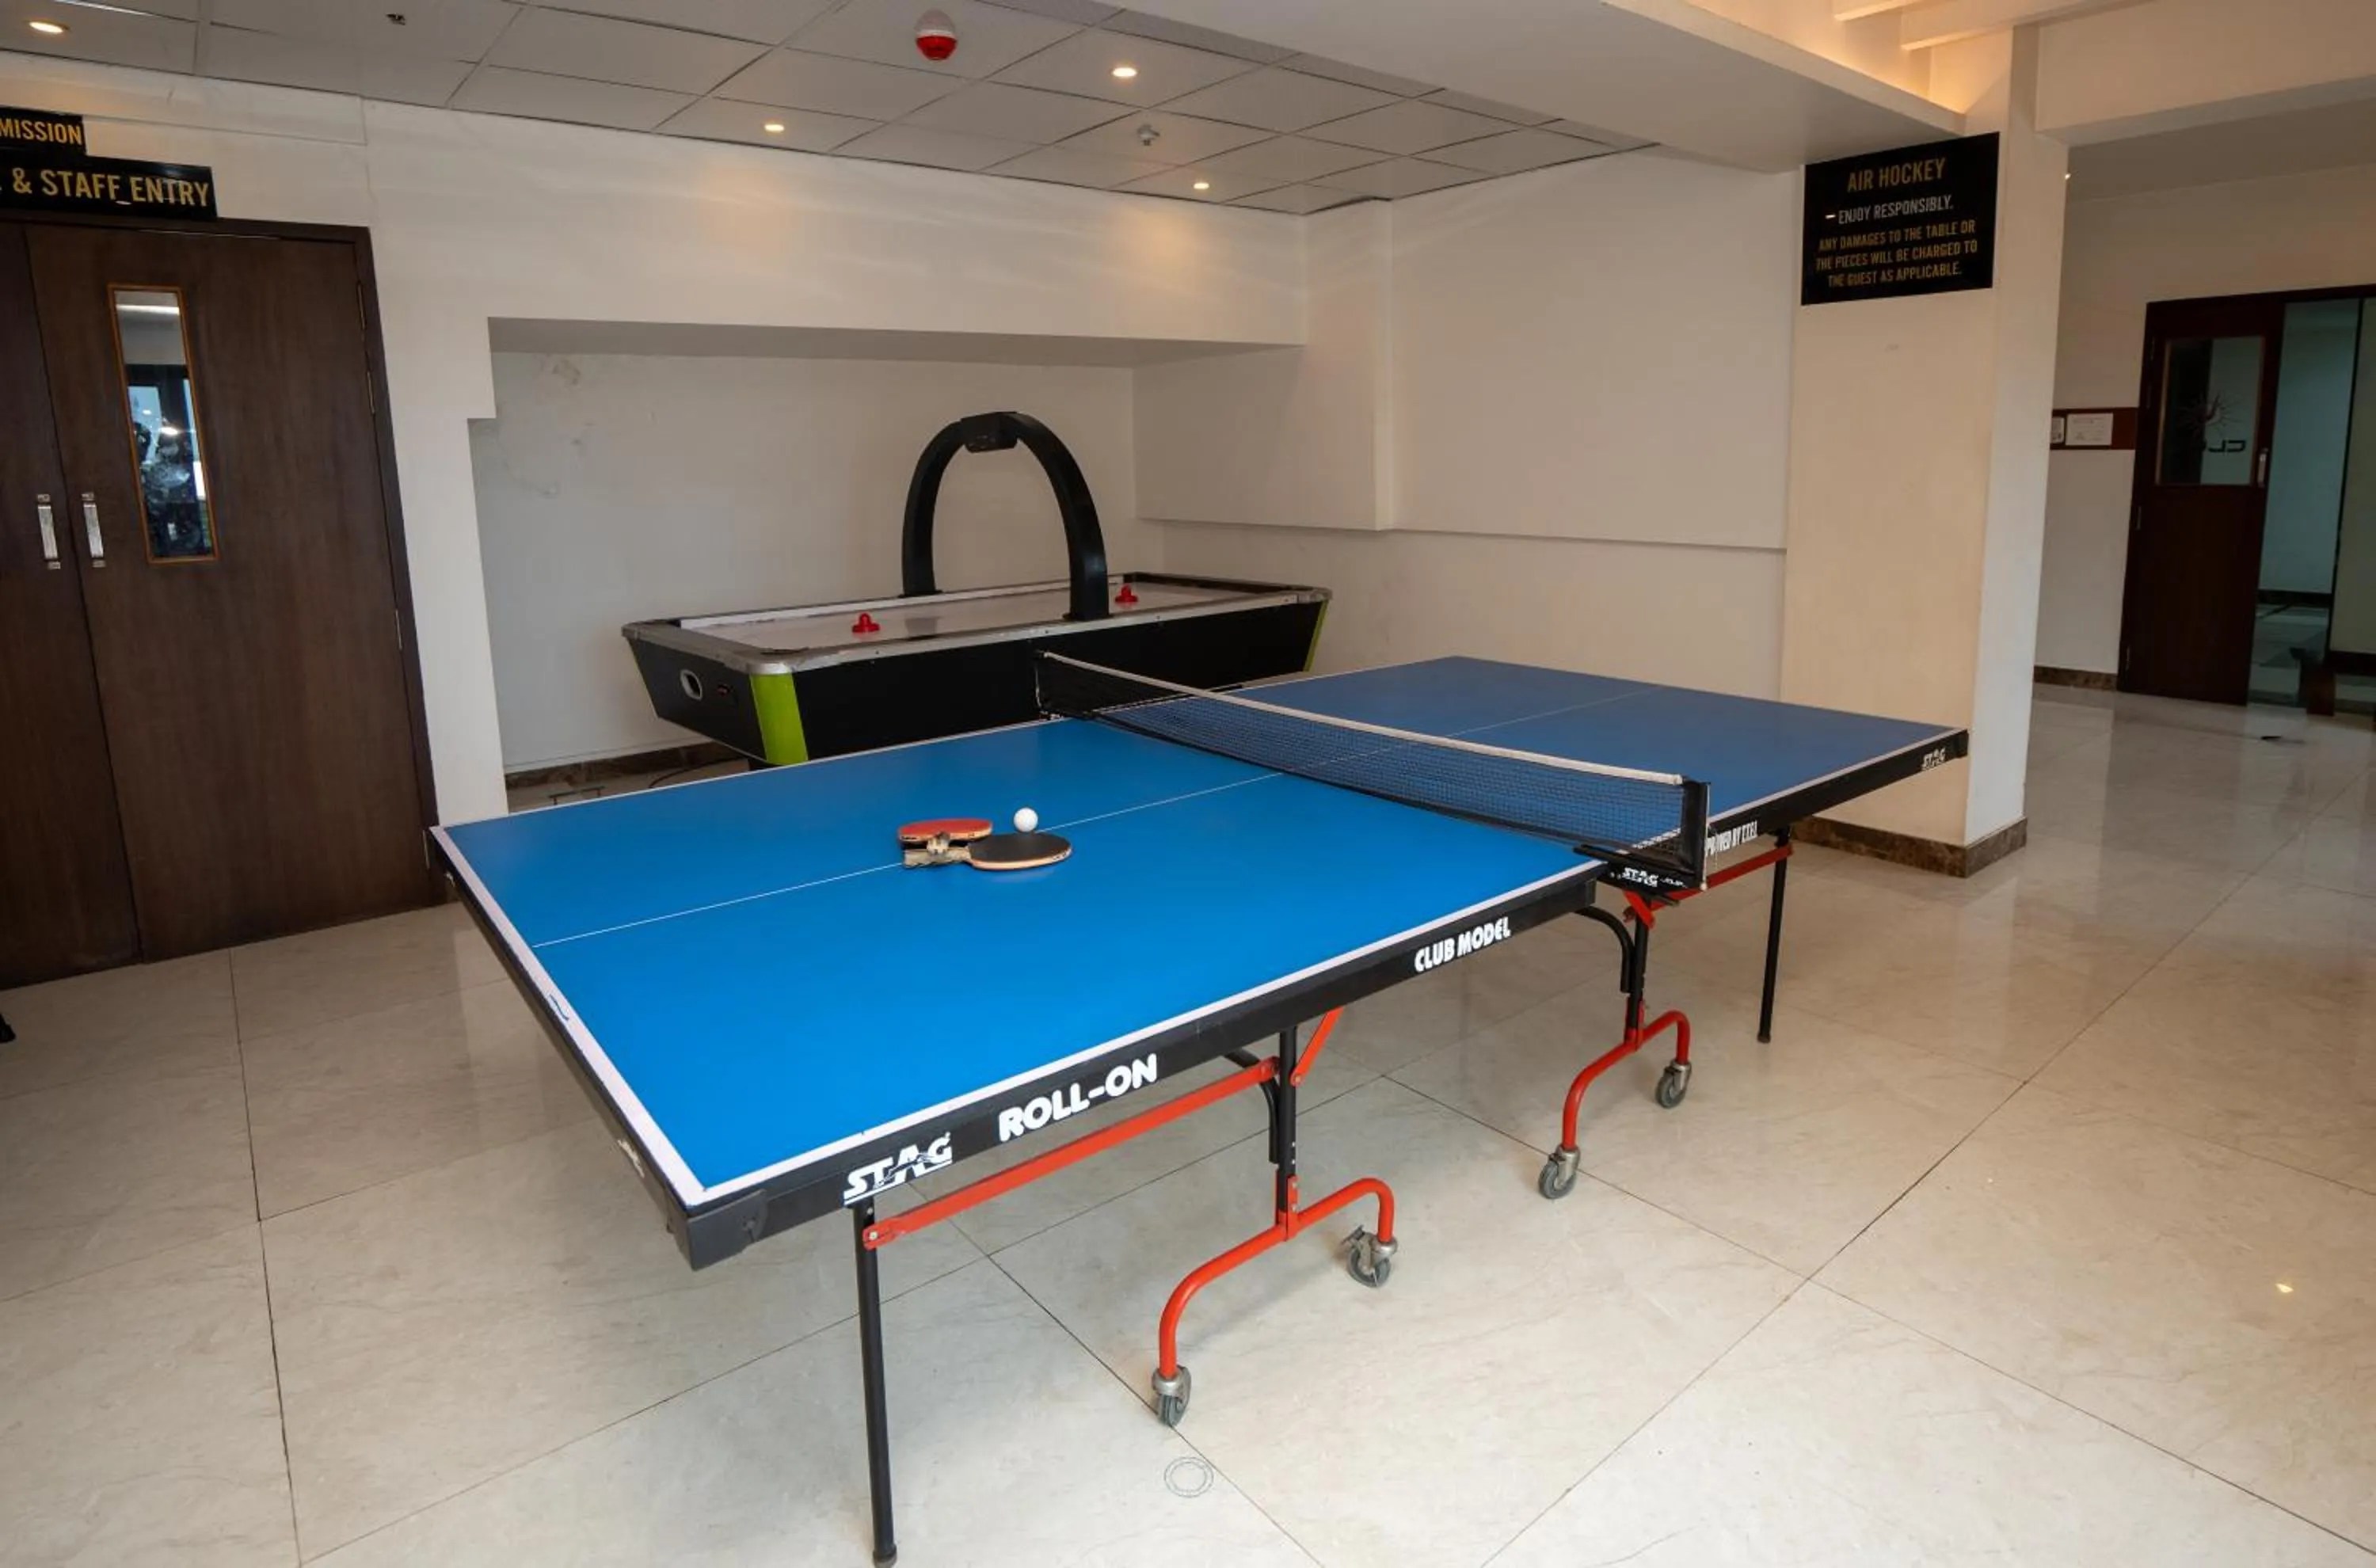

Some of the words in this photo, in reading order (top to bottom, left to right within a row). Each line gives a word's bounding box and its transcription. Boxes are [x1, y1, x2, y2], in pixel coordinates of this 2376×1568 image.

[12, 167, 32, 194] &
[40, 169, 120, 200] STAFF
[129, 176, 209, 207] ENTRY
[1847, 169, 1874, 193] AIR
[1879, 158, 1946, 188] HOCKEY
[1838, 205, 1871, 224] ENJOY
[1873, 195, 1954, 220] RESPONSIBLY.
[1818, 237, 1837, 252] ANY
[1840, 231, 1887, 249] DAMAGES
[1888, 230, 1901, 244] TO
[1904, 226, 1923, 242] THE
[1925, 221, 1959, 238] TABLE
[1960, 219, 1976, 234] OR
[1816, 257, 1834, 272] THE
[1835, 253, 1868, 268] PIECES
[1870, 250, 1893, 265] WILL
[1896, 248, 1910, 262] BE
[1912, 242, 1961, 260] CHARGED
[1963, 239, 1978, 254] TO
[1828, 274, 1846, 287] THE
[1847, 270, 1877, 286] GUEST
[1880, 268, 1894, 282] AS
[1895, 261, 1963, 281] APPLICABLE.
[1623, 867, 1658, 888] STAG
[1415, 937, 1455, 972] CLUB
[1457, 916, 1511, 957] MODEL
[998, 1053, 1157, 1142] ROLL-ON
[843, 1132, 953, 1205] STAG
